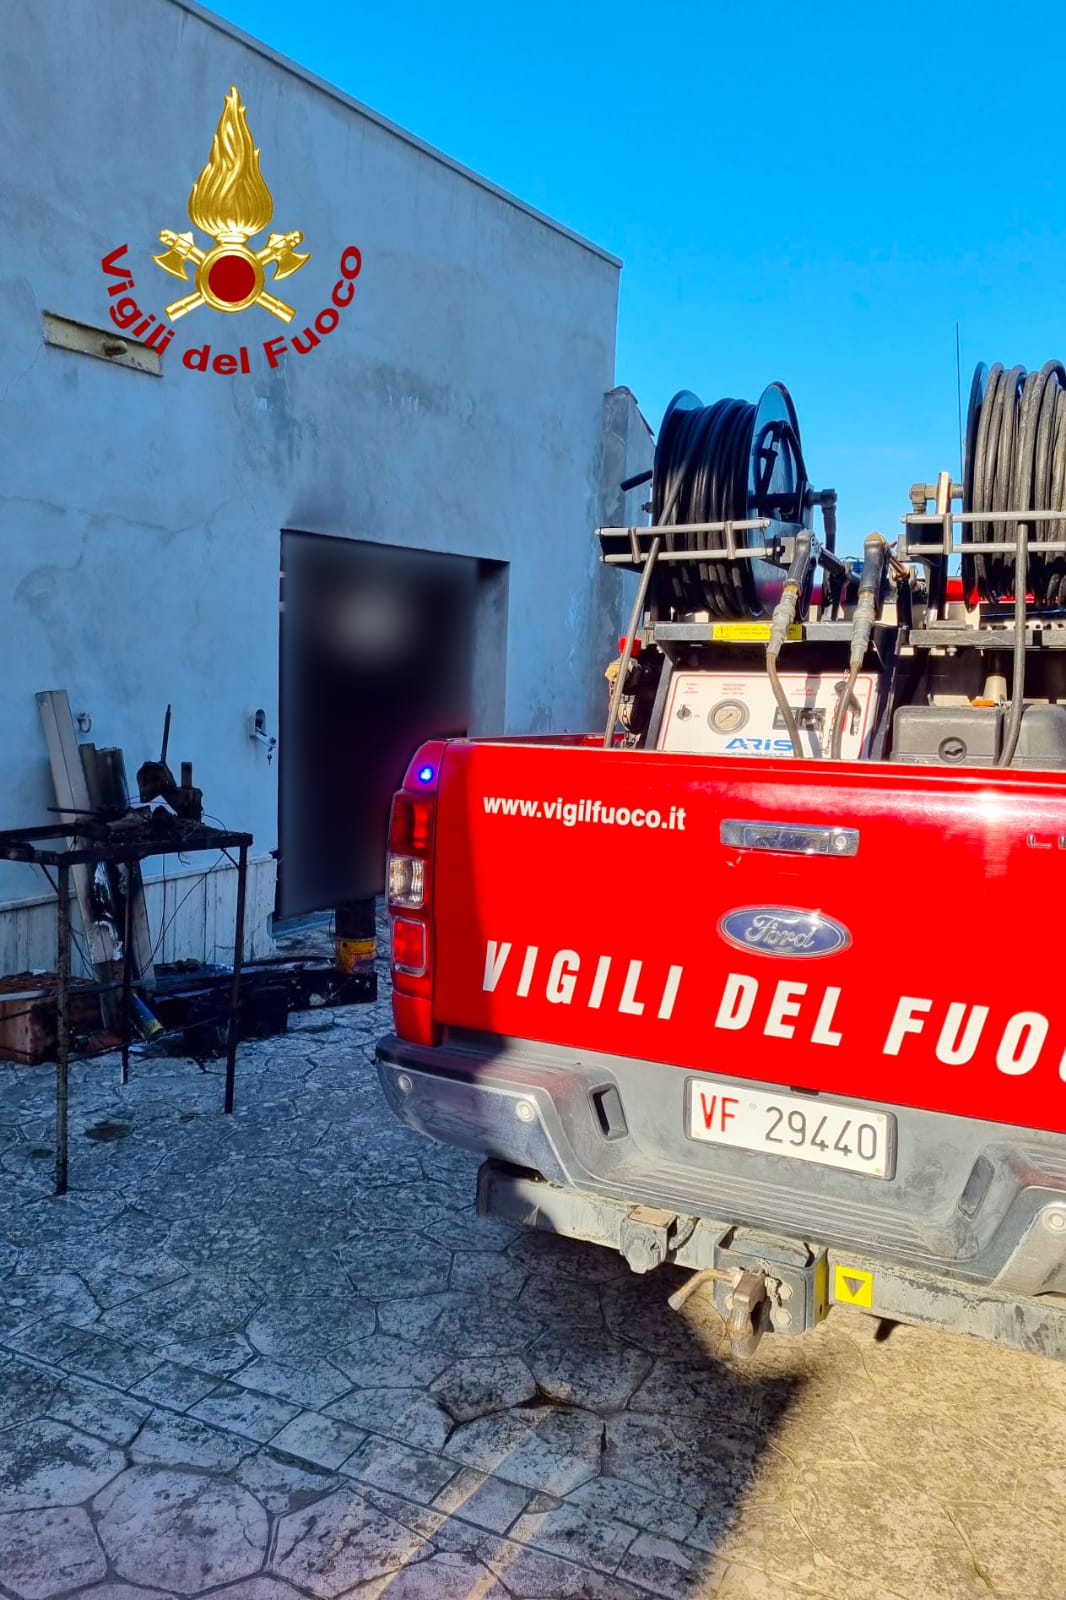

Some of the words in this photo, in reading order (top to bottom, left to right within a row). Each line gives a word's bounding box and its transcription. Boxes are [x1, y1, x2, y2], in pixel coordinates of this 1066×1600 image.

[483, 796, 687, 831] www.vigilfuoco.it
[744, 914, 815, 949] Ford
[482, 939, 684, 1020] VIGILI
[714, 972, 843, 1047] DEL
[882, 995, 1066, 1084] FUO
[700, 1092, 739, 1132] VF
[765, 1106, 877, 1160] 29440
